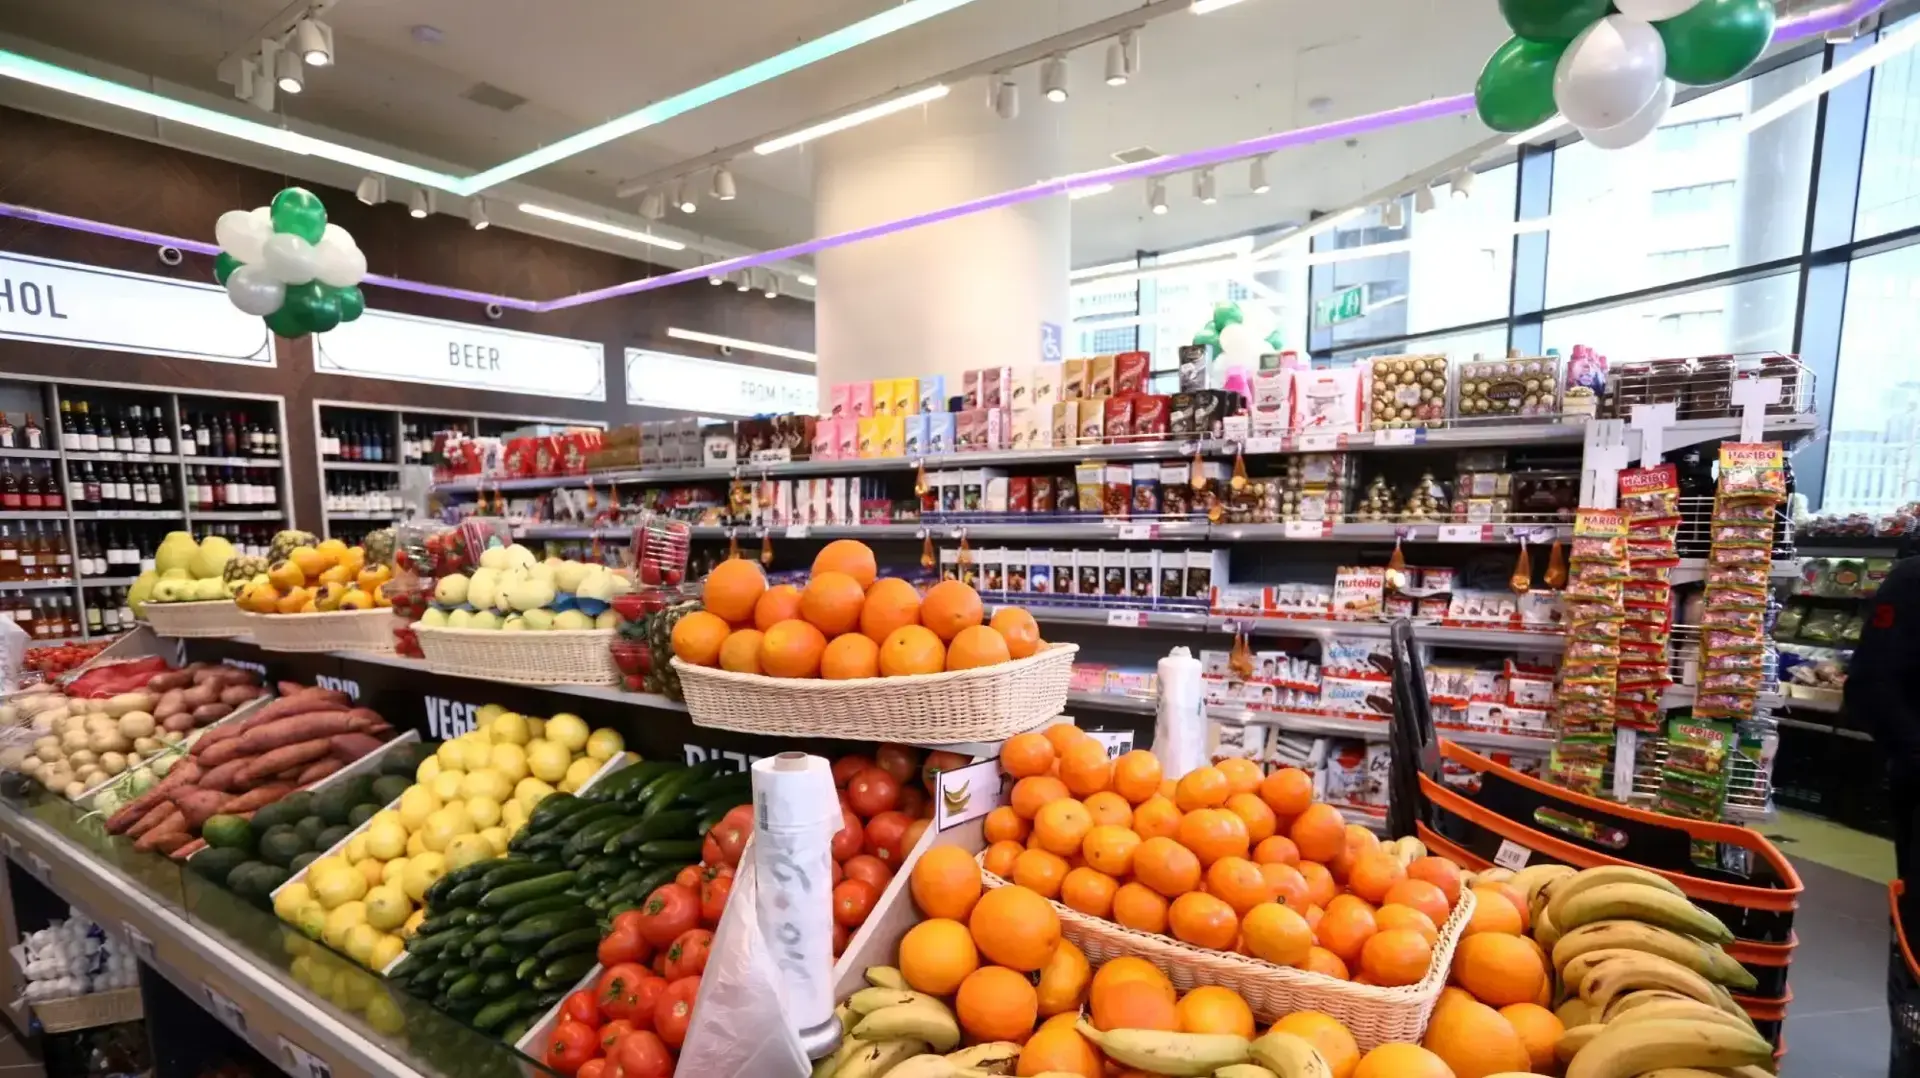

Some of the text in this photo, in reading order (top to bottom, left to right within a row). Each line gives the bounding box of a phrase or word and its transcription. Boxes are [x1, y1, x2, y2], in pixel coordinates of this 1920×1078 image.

[449, 342, 501, 371] BEER
[741, 381, 775, 401] FROM
[1727, 451, 1777, 460] HARIBO
[1622, 472, 1669, 487] HARIBO
[1583, 515, 1625, 526] HARIBO
[1337, 578, 1381, 588] nutella
[1678, 724, 1724, 741] HARIBO
